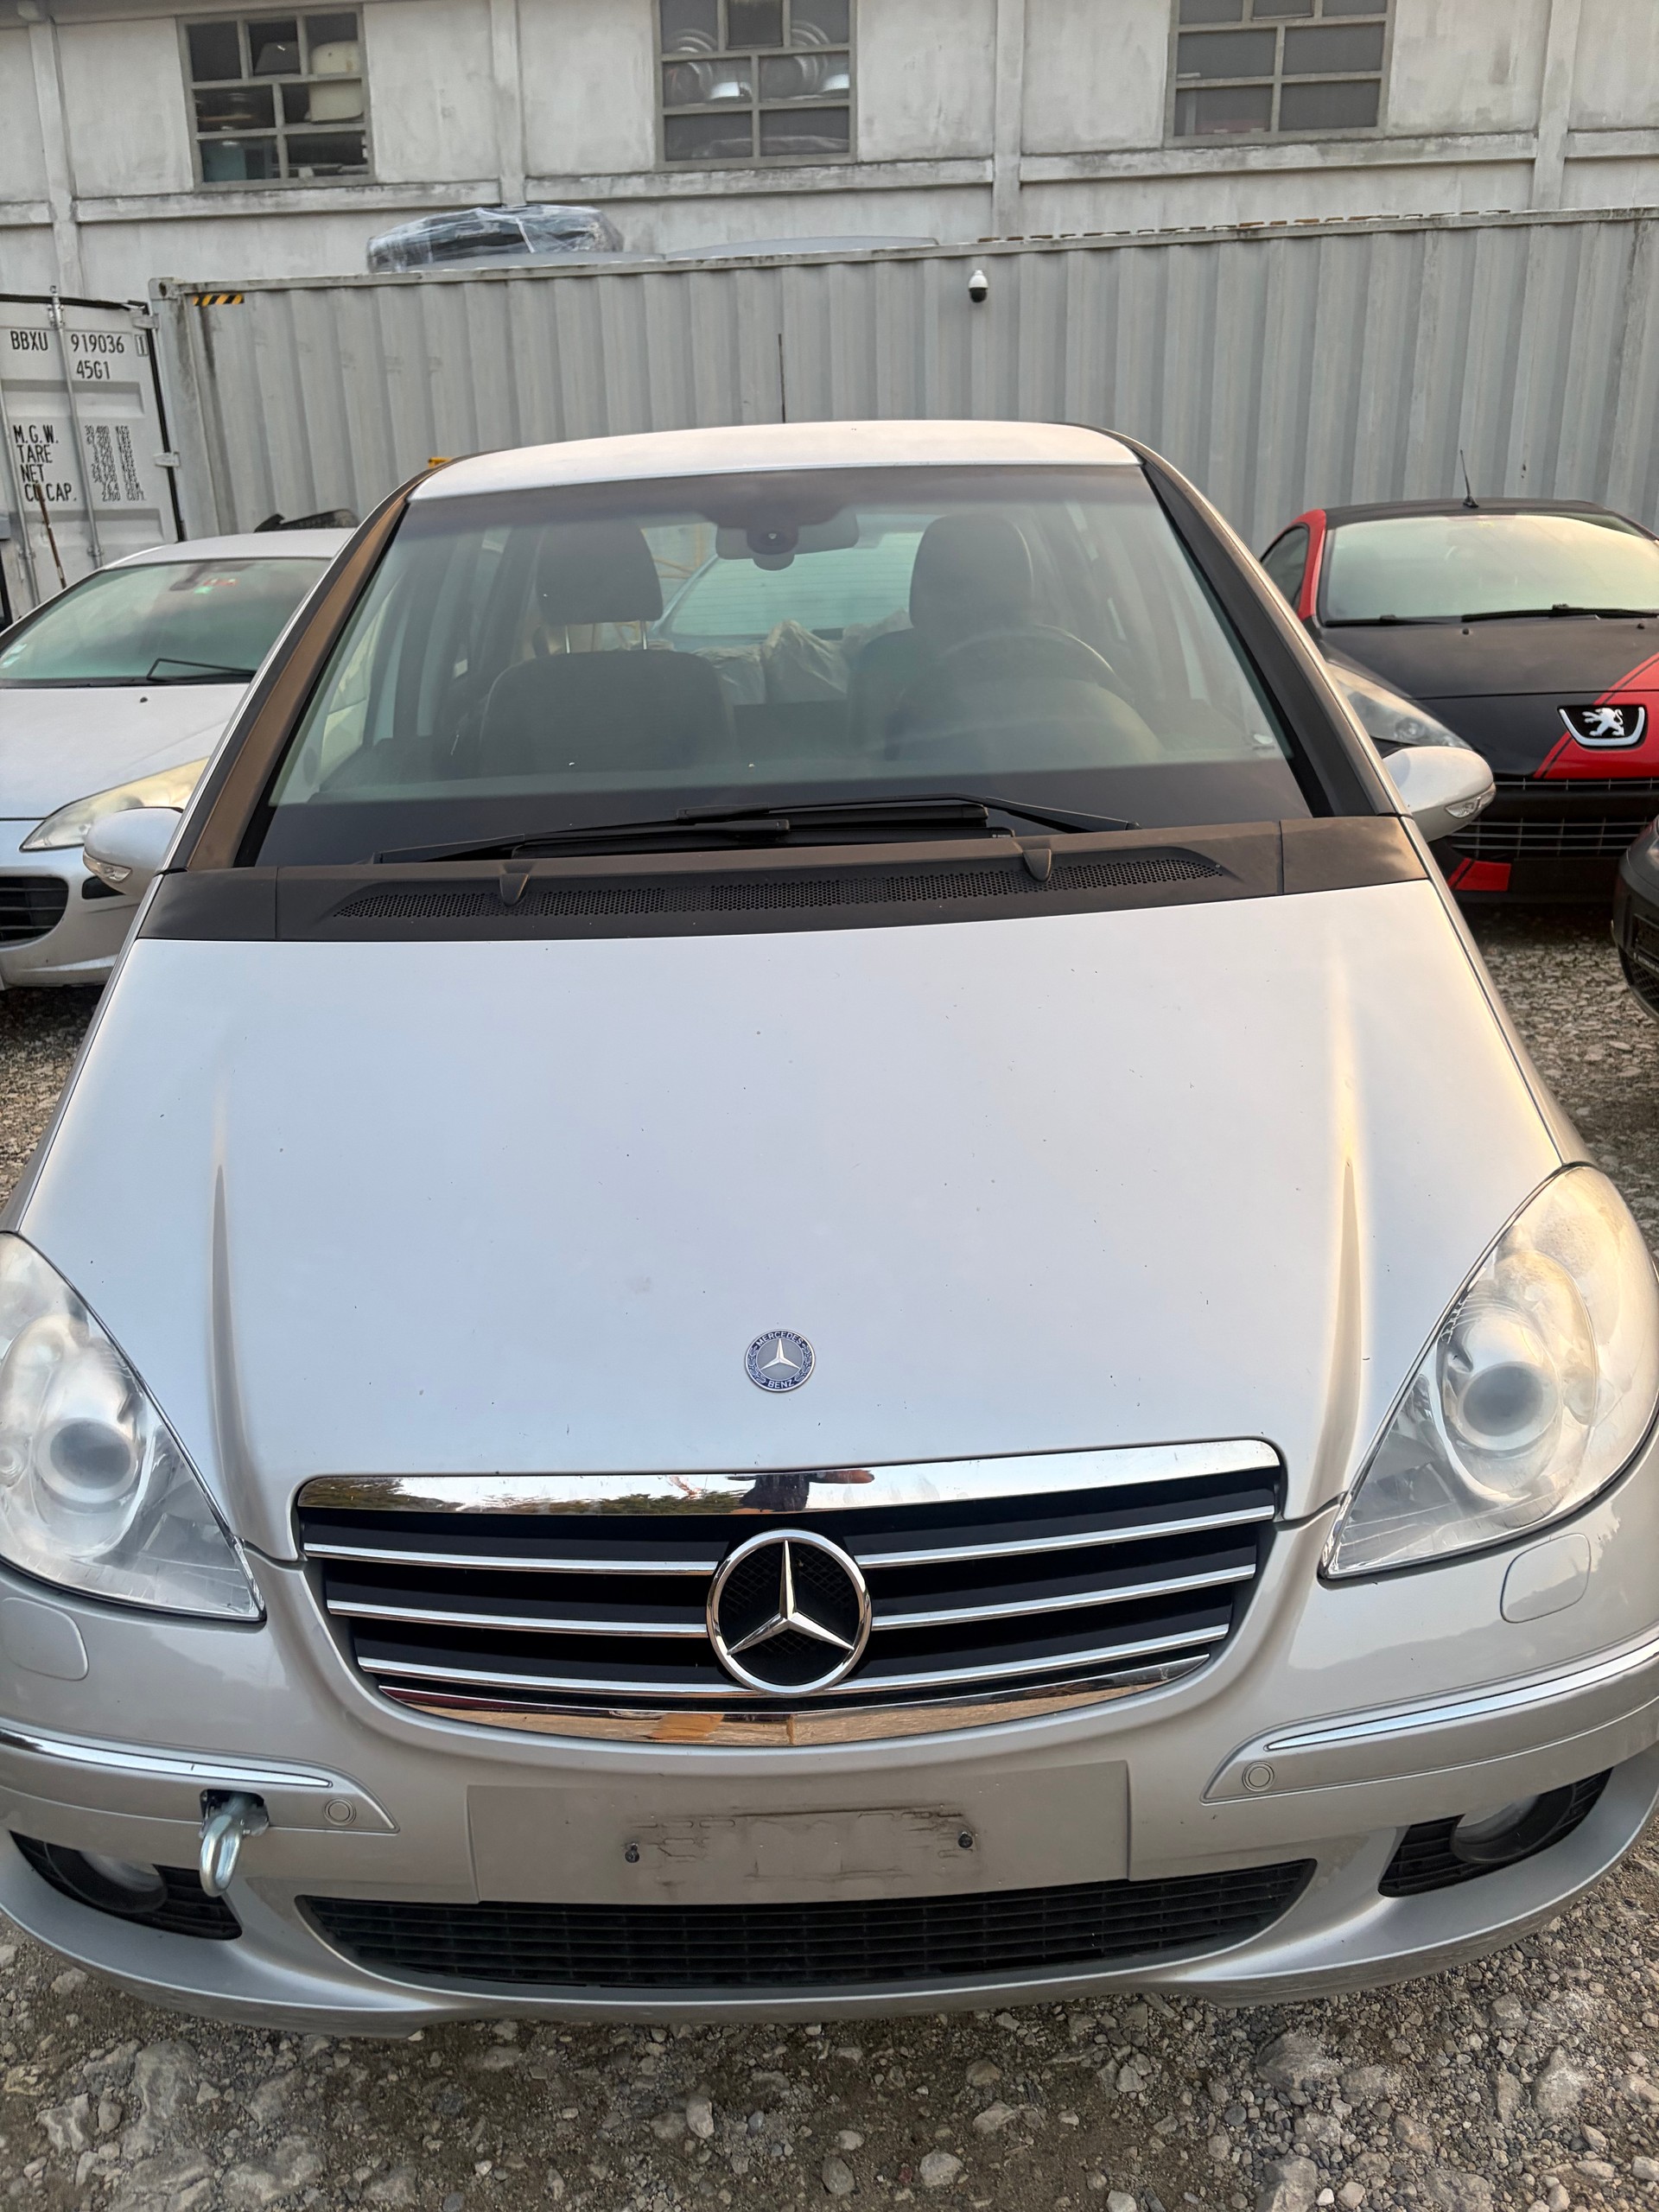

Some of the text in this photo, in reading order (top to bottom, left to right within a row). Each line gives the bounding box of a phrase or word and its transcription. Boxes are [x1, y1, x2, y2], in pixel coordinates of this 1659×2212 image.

[10, 331, 48, 351] BBXU
[70, 334, 124, 353] 919036
[76, 359, 111, 379] 45G1
[13, 424, 59, 444] M.G.W.
[16, 444, 53, 463] TARE
[20, 464, 44, 484] NET
[756, 1332, 804, 1346] MERCEDES
[767, 1379, 794, 1389] BENZ
